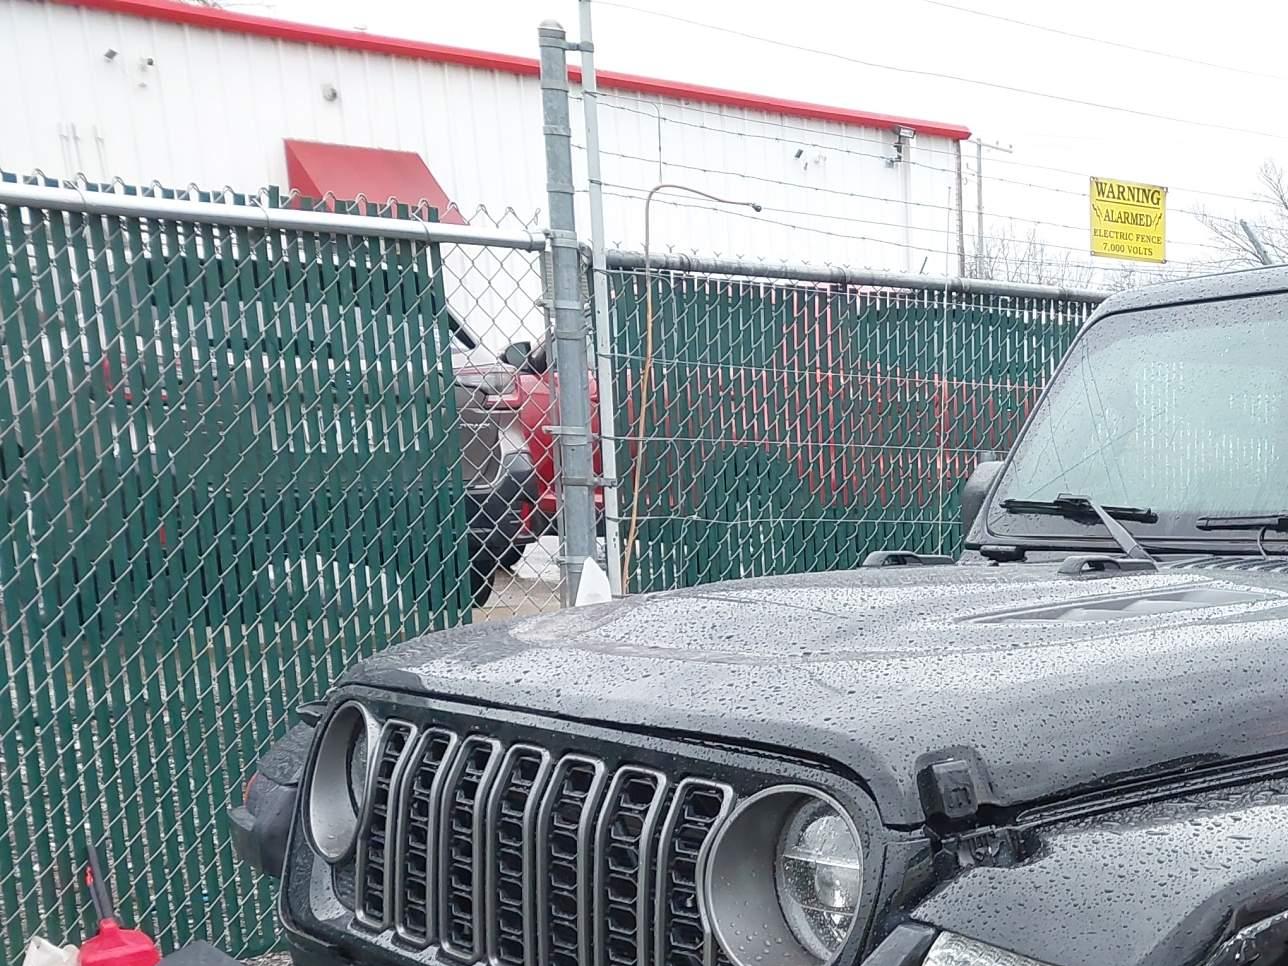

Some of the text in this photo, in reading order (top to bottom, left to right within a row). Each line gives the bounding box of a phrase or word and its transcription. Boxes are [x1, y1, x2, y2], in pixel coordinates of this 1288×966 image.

[1095, 181, 1161, 206] WARNING
[1104, 209, 1153, 227] ALARMED
[1093, 228, 1162, 245] ELECTRIC FENCE
[1127, 245, 1153, 256] VOLTS
